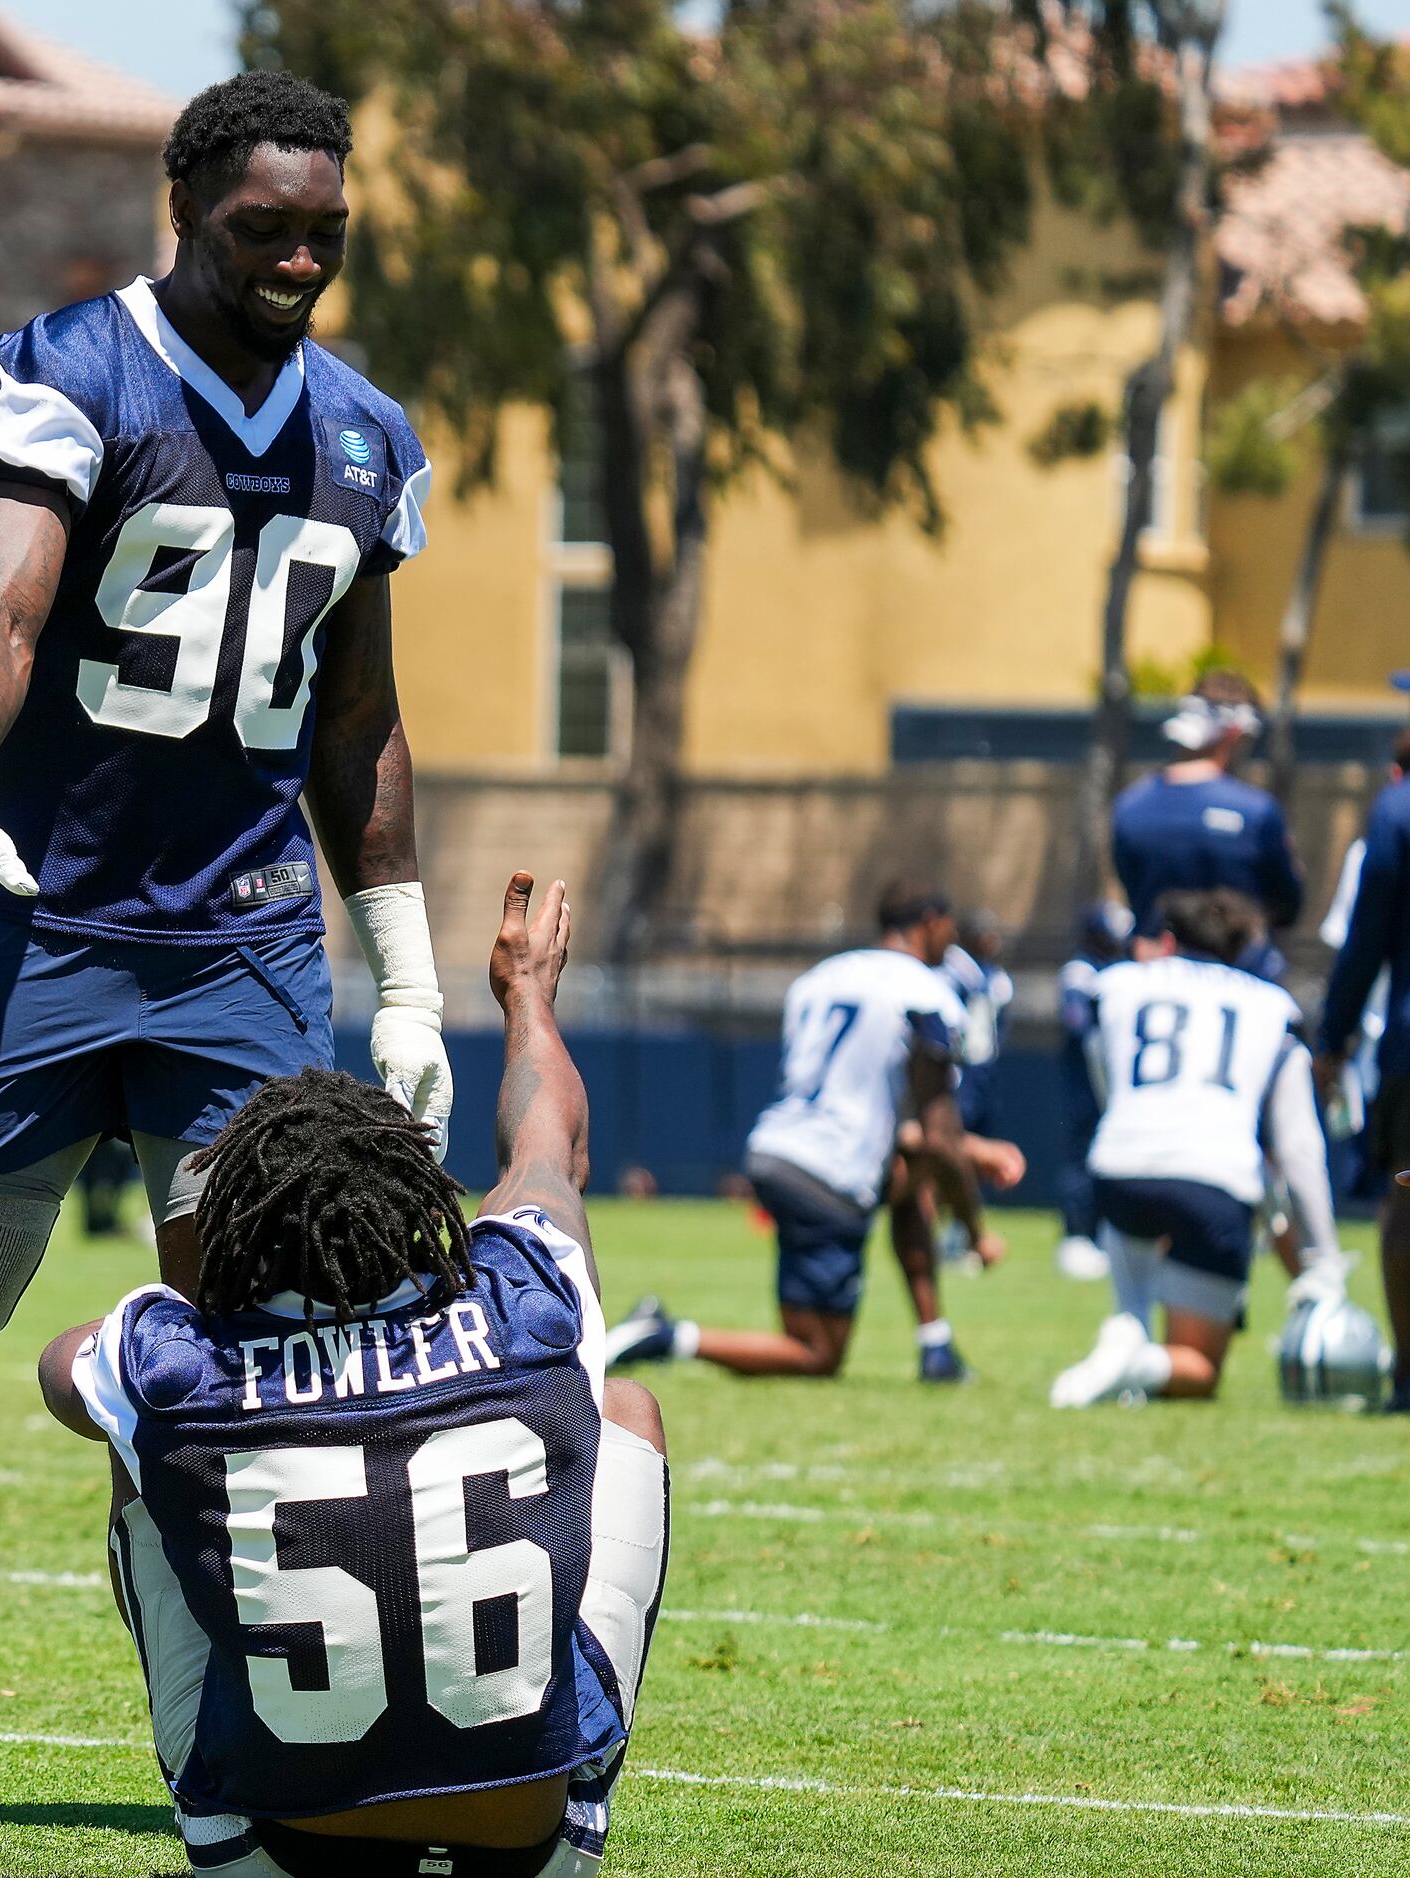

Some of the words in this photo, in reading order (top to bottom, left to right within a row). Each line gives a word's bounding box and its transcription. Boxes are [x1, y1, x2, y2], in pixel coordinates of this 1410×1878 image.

[226, 473, 290, 493] COWBOYS
[344, 465, 378, 488] AT&T
[76, 502, 361, 749] 90
[270, 868, 290, 883] 50
[1131, 1001, 1238, 1090] 81
[239, 1302, 501, 1410] FOWLER
[224, 1417, 553, 1743] 56
[426, 1860, 450, 1868] 56
